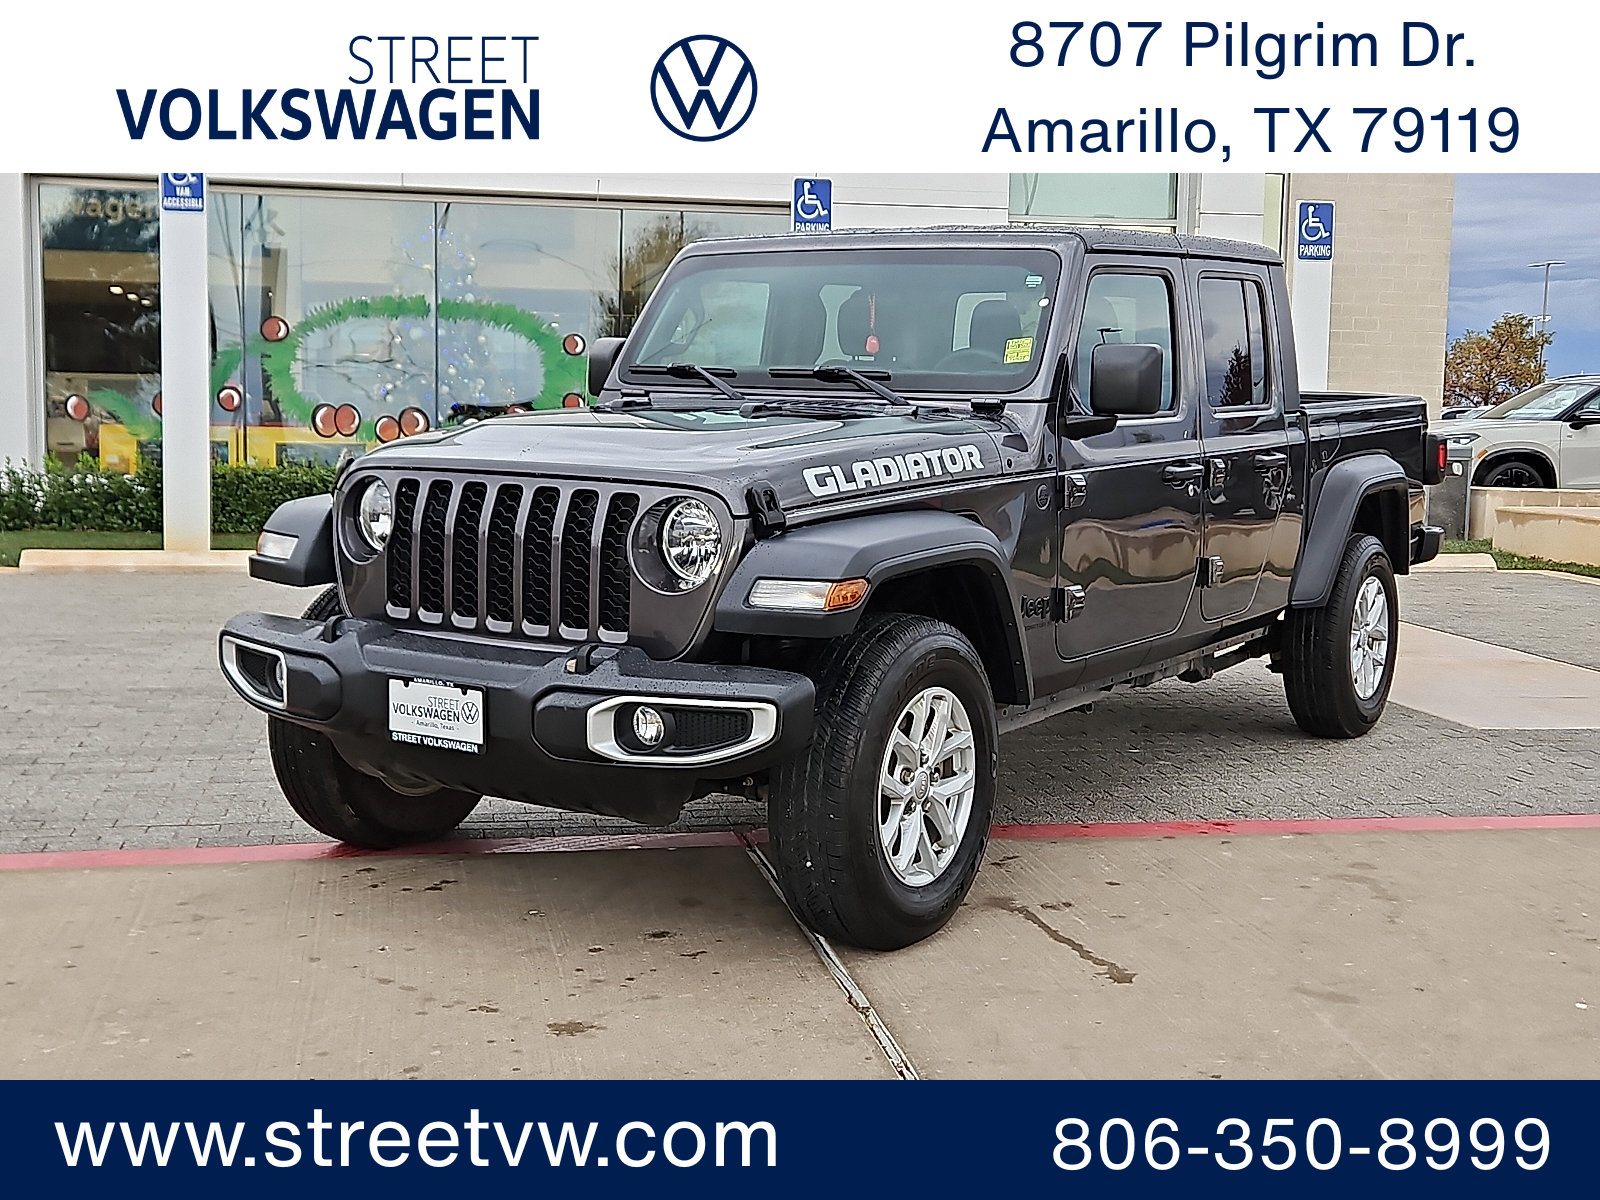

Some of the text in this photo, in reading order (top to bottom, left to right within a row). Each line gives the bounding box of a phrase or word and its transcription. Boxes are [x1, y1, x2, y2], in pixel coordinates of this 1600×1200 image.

[175, 186, 191, 197] VAN
[163, 196, 203, 208] ACCESSIBLE
[795, 222, 830, 232] PARKING
[1299, 244, 1331, 257] PARKING
[802, 444, 985, 498] GLADIATOR
[427, 696, 460, 711] STREET
[392, 702, 460, 723] VOLKSWAGEN
[416, 719, 455, 731] Amarillo, Texas
[392, 731, 479, 754] STREET VOLKSWAGEN
